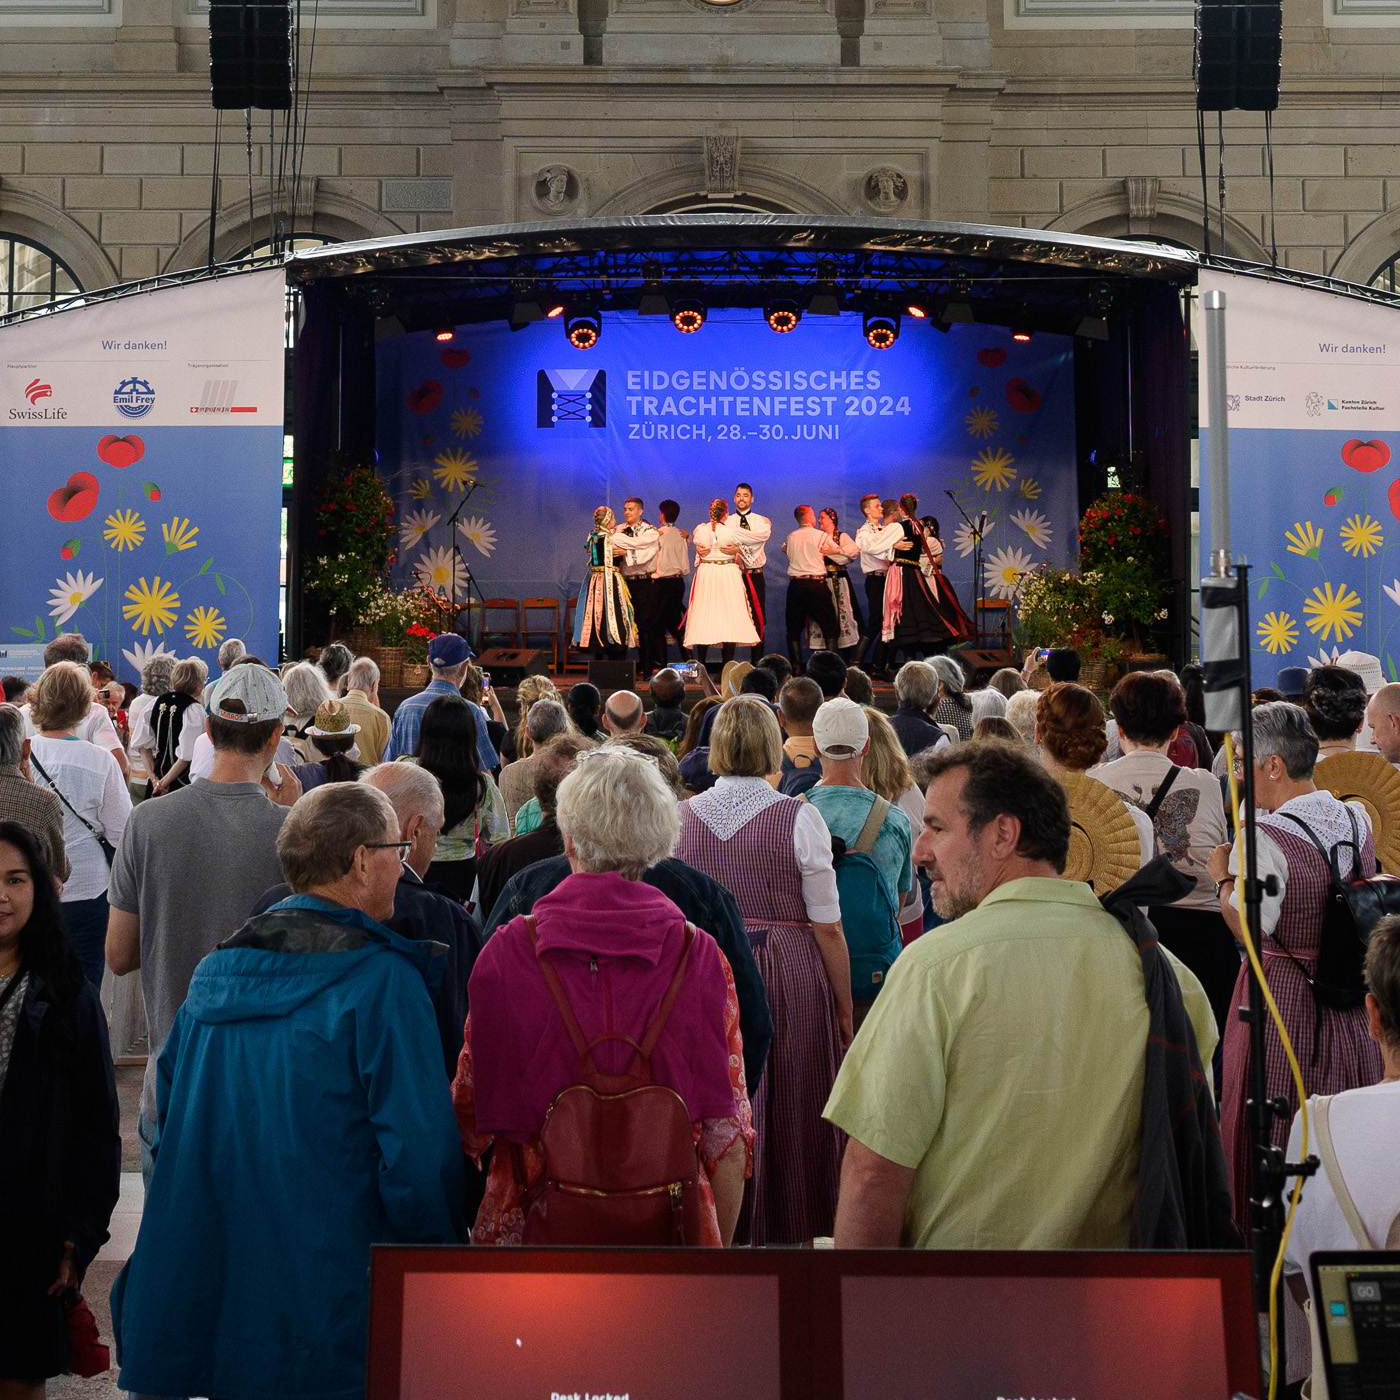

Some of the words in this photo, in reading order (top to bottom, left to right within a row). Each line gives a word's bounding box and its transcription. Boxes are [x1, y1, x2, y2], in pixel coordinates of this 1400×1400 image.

[101, 340, 121, 350] Wir
[123, 340, 167, 350] danken!
[1318, 343, 1339, 353] Wir
[1342, 343, 1386, 354] danken!
[626, 366, 881, 391] EIDGENÖSSISCHES
[113, 395, 133, 404] Emil
[135, 395, 156, 405] Frey
[1244, 394, 1263, 402] Stadt
[1264, 394, 1286, 402] Zürich
[626, 396, 838, 416] TRACHTENFEST
[844, 396, 912, 416] 2024
[628, 421, 712, 442] ZÜRICH,
